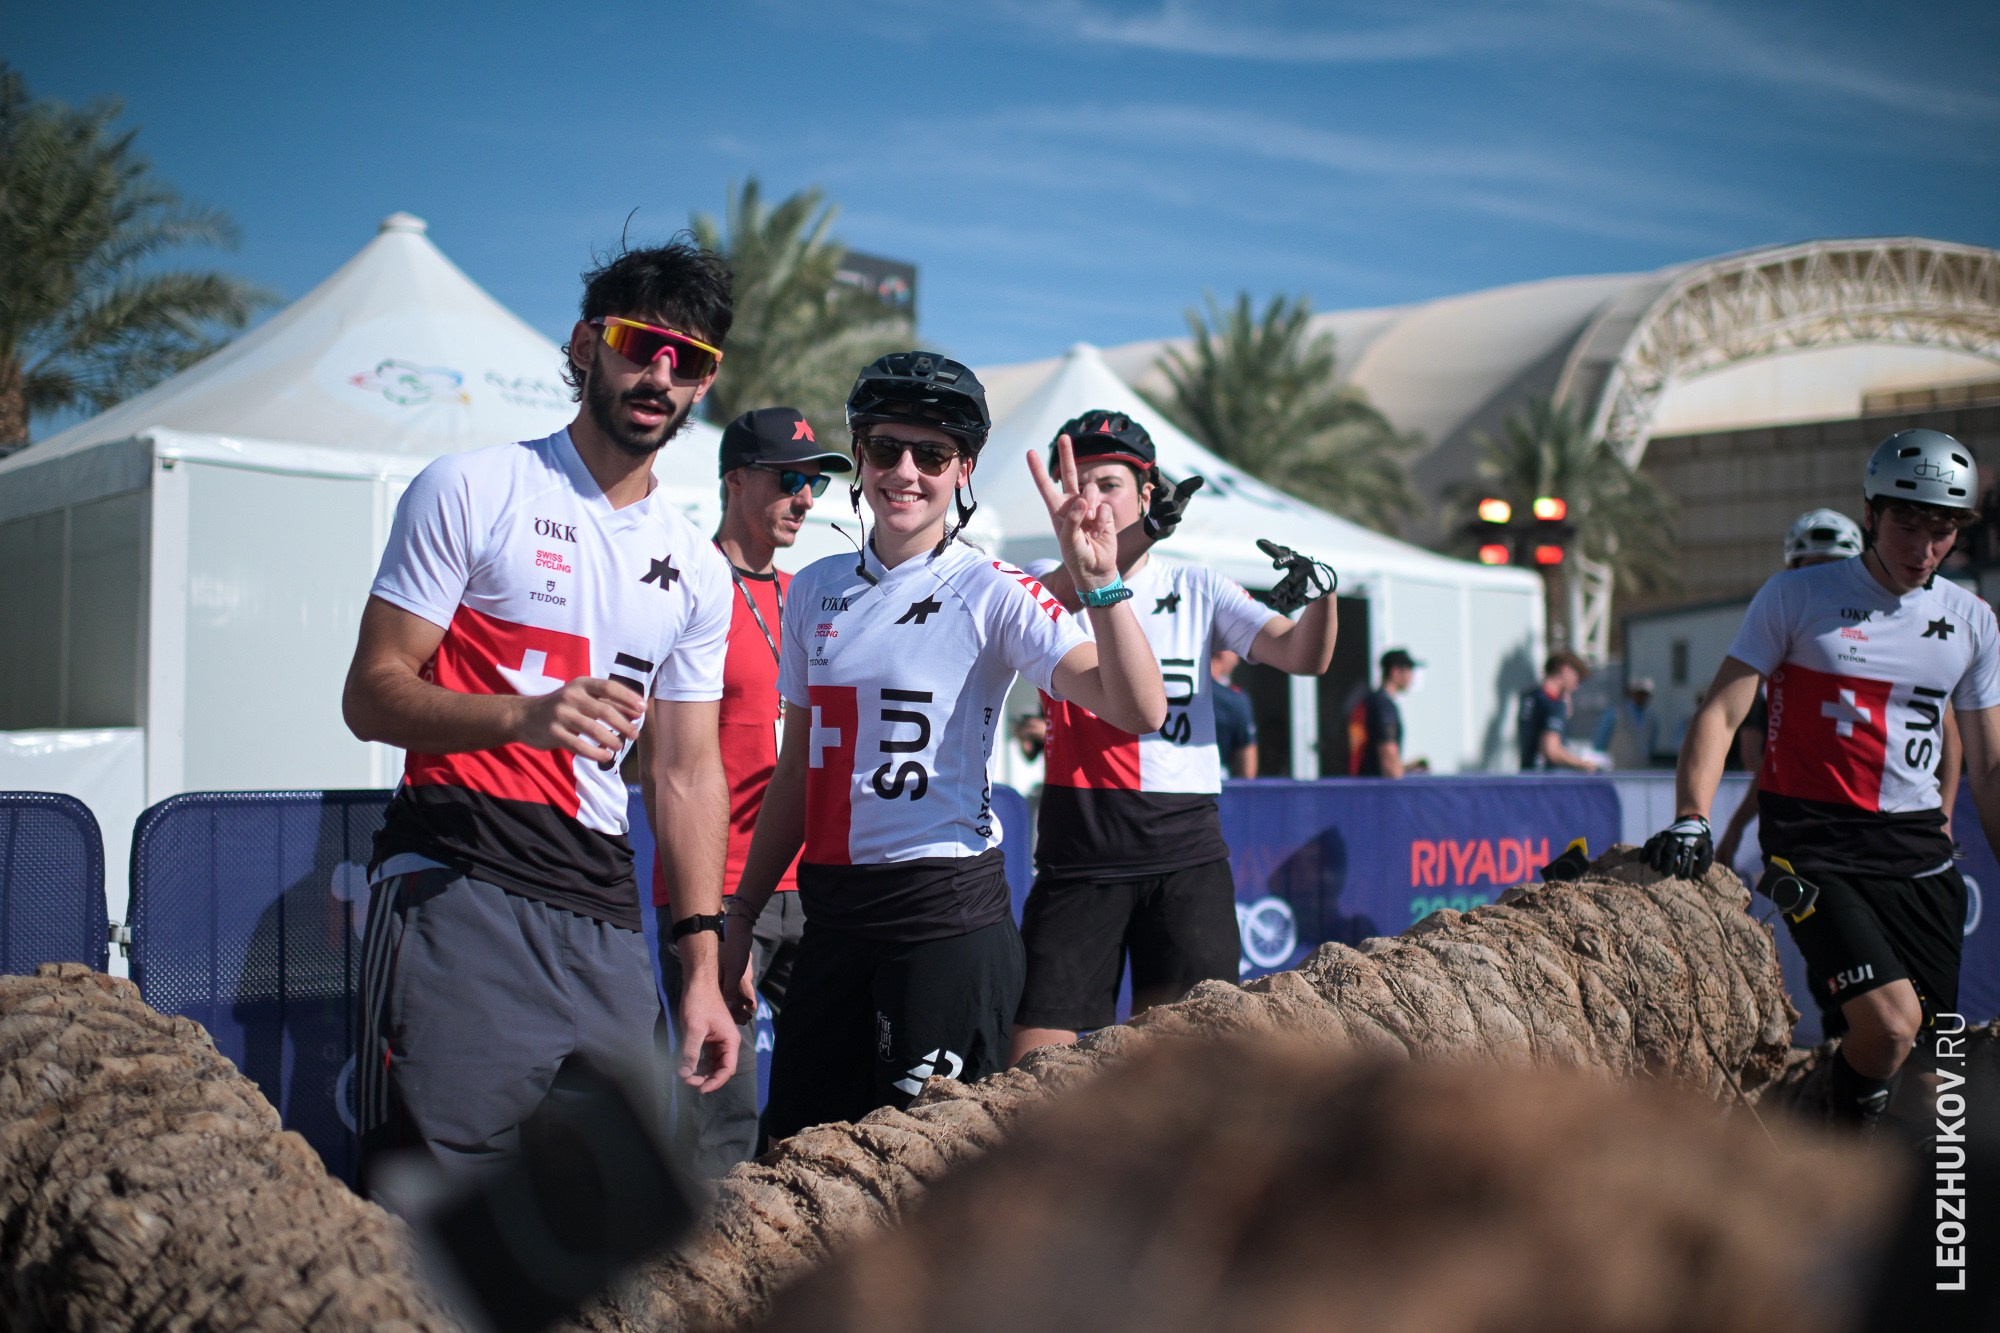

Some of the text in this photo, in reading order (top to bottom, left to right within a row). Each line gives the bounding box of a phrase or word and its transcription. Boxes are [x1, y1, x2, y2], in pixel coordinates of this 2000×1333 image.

[534, 517, 578, 543] ÖKK
[536, 550, 563, 563] SWISS
[535, 559, 572, 574] CYCLING
[529, 591, 567, 606] TUDOR
[821, 596, 852, 612] ÖKK
[814, 630, 839, 638] CYCLING
[816, 623, 833, 631] SWISS
[1837, 653, 1867, 664] TUDOR
[1158, 658, 1195, 745] SUI
[1904, 686, 1948, 770] SUI
[871, 687, 934, 802] SUI
[1410, 837, 1550, 888] RIYADH
[1836, 963, 1874, 990] SUI
